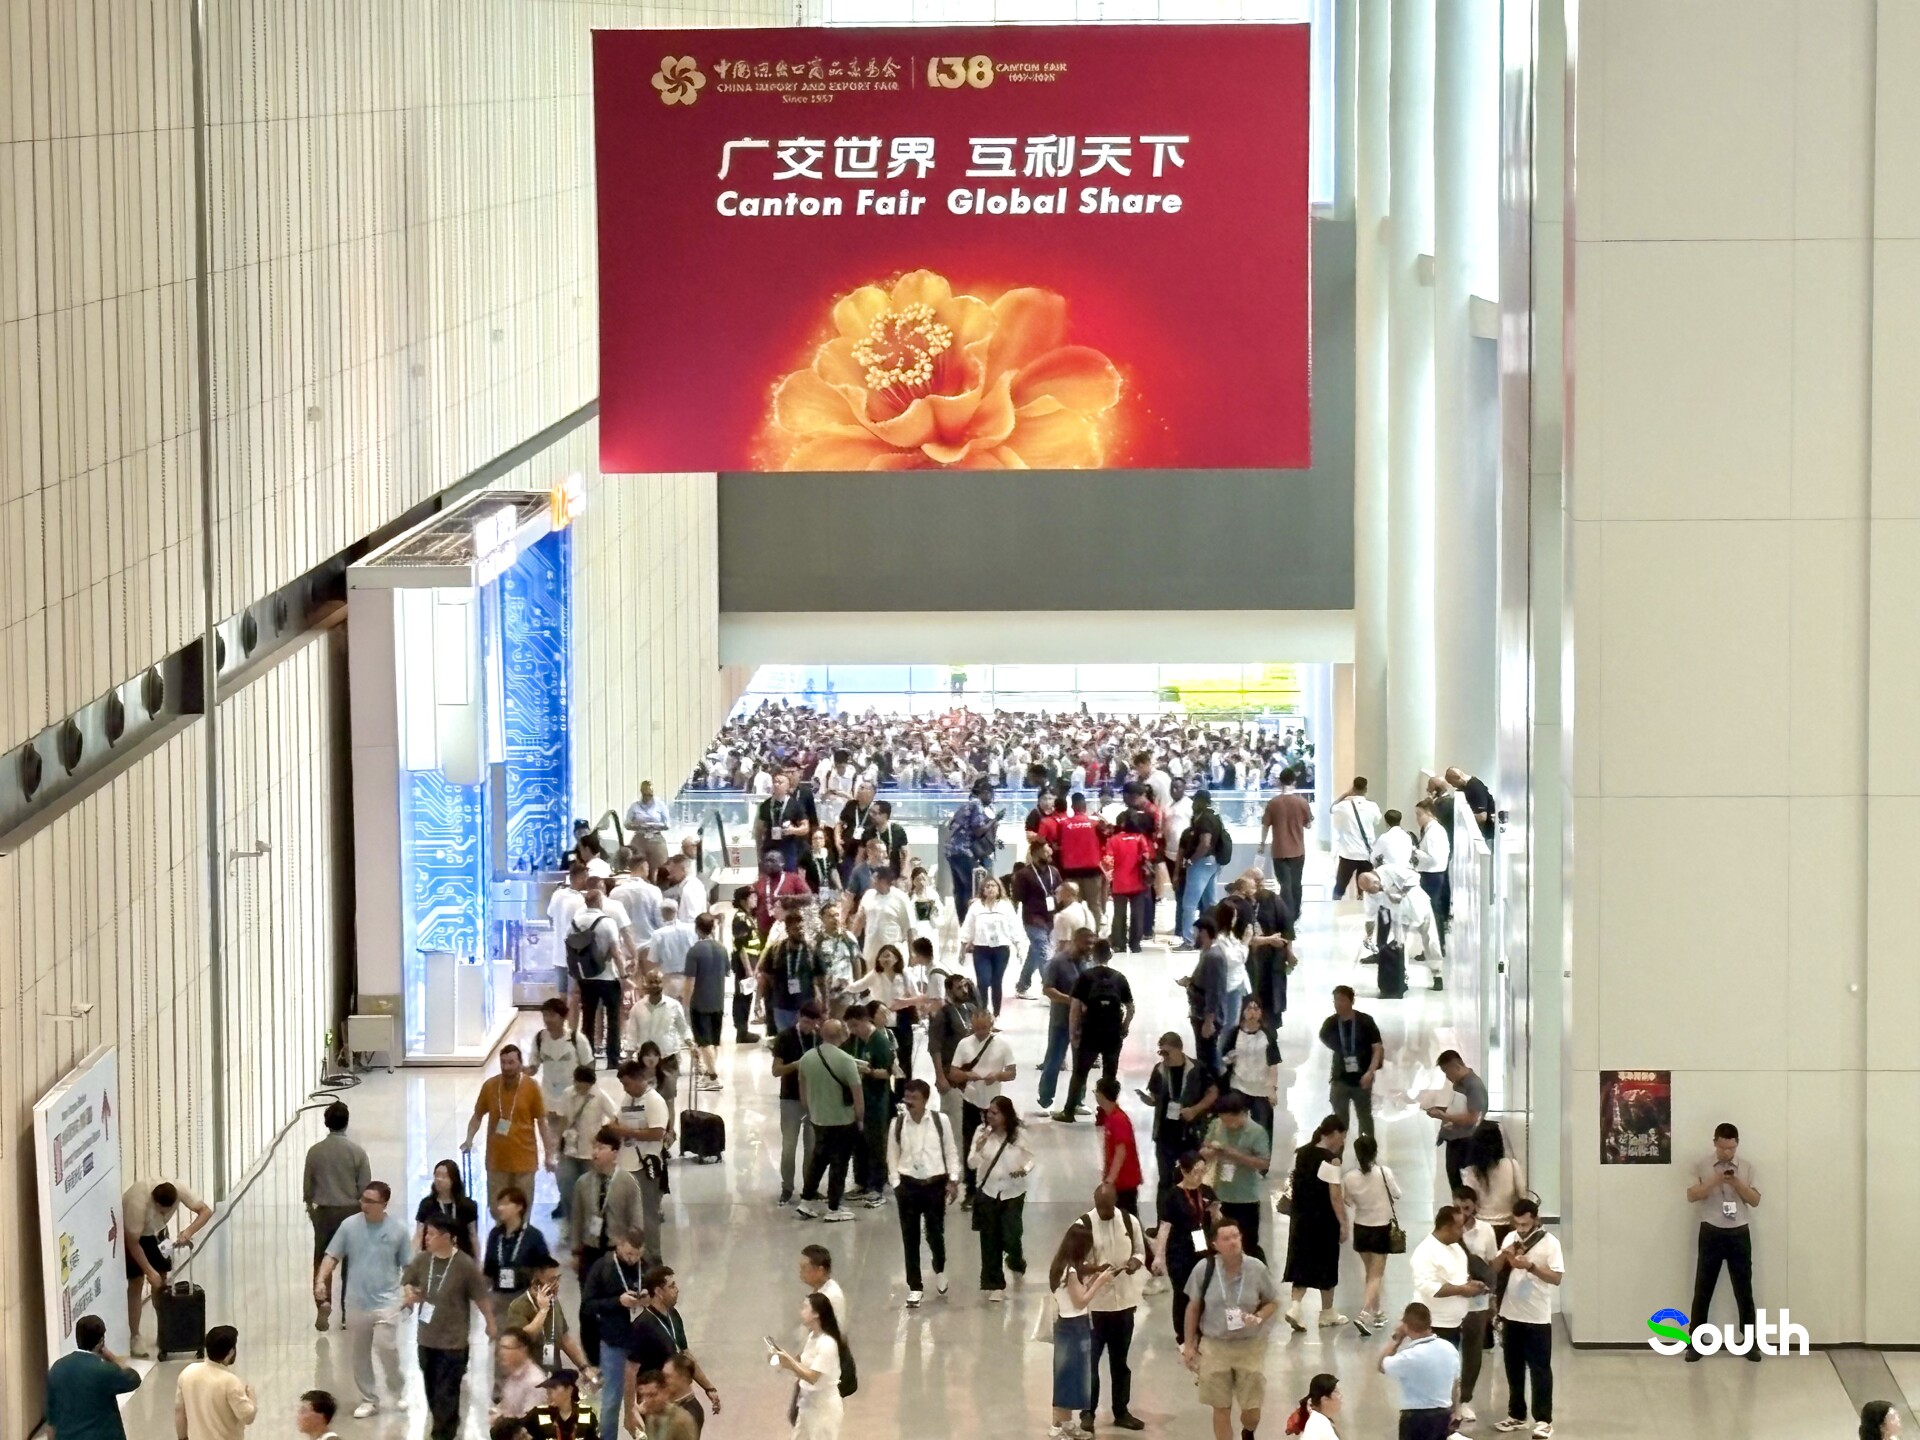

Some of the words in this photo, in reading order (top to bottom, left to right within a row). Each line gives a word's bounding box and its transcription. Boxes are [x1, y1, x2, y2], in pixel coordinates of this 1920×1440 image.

[927, 54, 995, 89] 138
[716, 83, 753, 93] CHINA
[801, 82, 826, 91] AND
[829, 82, 871, 91] EXPORT
[874, 82, 900, 91] FAIR
[782, 94, 808, 103] Since
[717, 136, 935, 180] 广交世界
[965, 134, 1190, 178] 互利天下
[716, 190, 842, 217] Canton
[856, 188, 927, 216] Fair
[947, 187, 1068, 215] Global
[1078, 186, 1183, 214] Share
